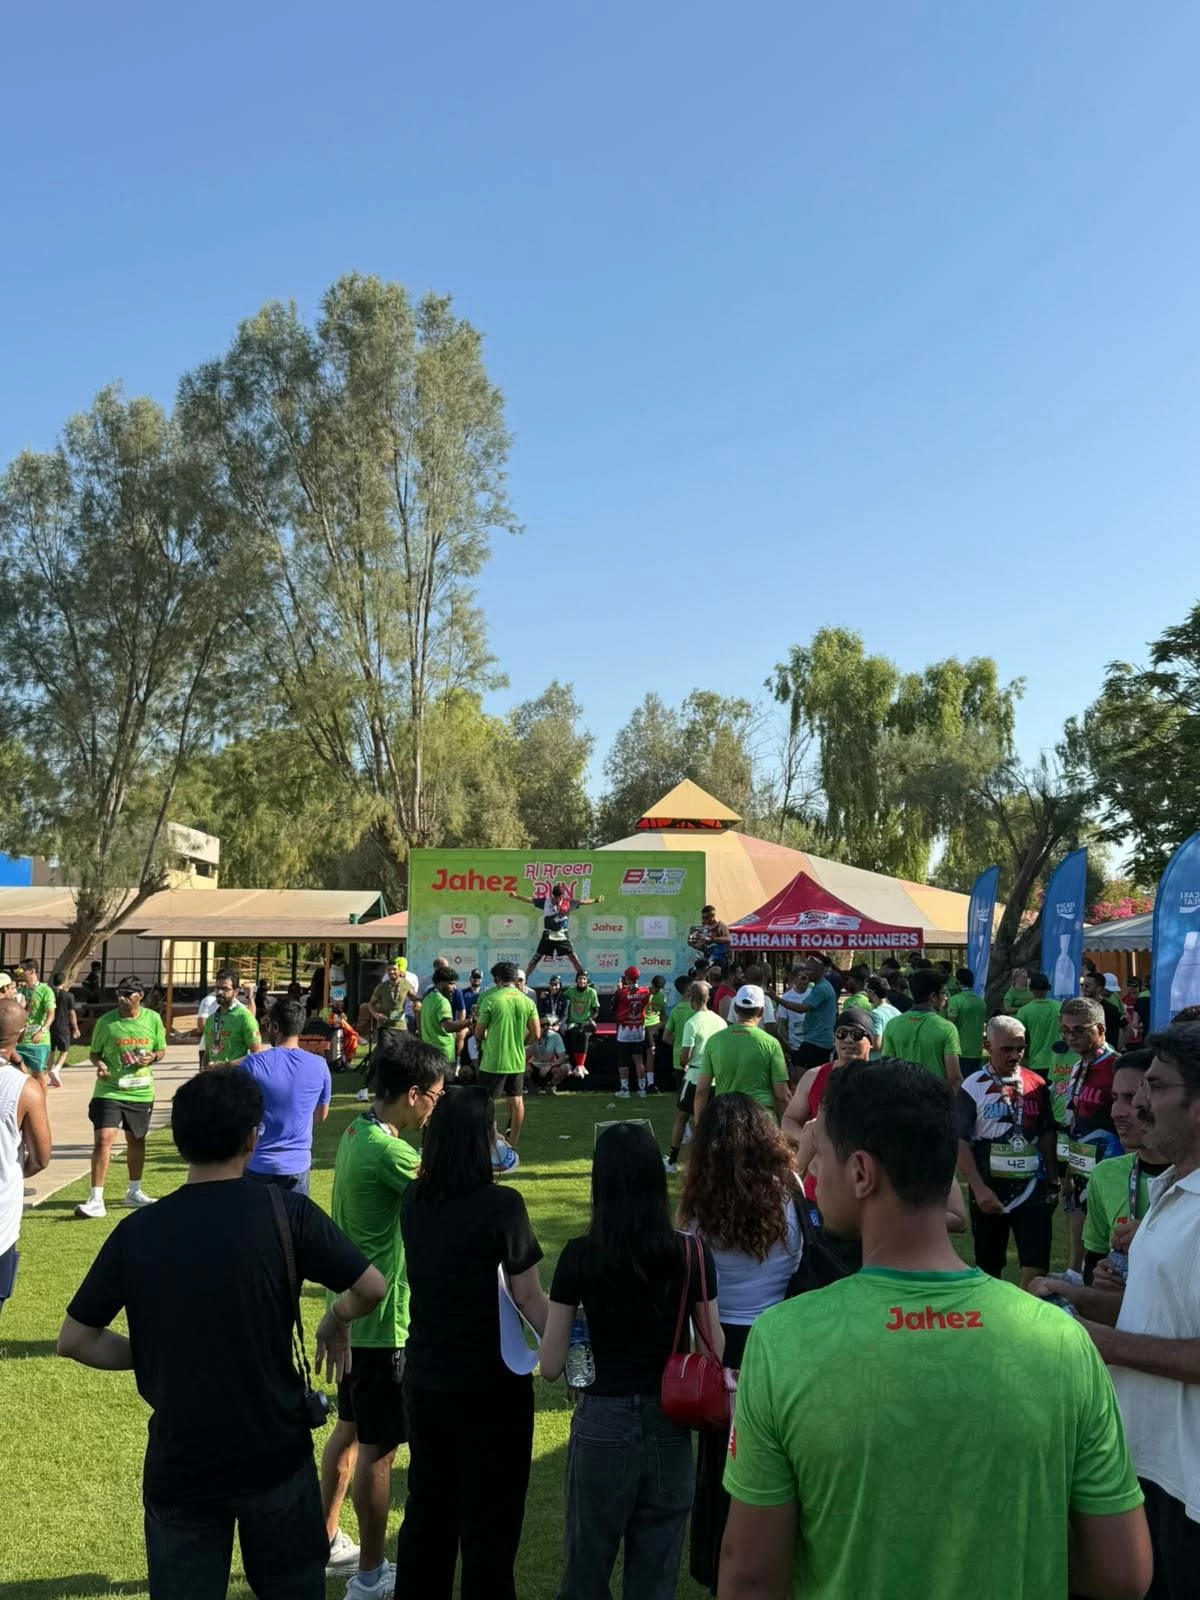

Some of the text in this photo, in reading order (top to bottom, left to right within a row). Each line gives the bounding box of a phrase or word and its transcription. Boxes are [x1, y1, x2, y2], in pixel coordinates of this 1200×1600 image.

[543, 863, 592, 879] Areen
[431, 869, 518, 892] Jahez
[592, 922, 624, 932] Jahez
[729, 933, 918, 947] BAHRAIN ROAD RUNNERS
[640, 956, 672, 966] Jahez
[1007, 1159, 1026, 1169] 42
[885, 1306, 983, 1331] Jahez
